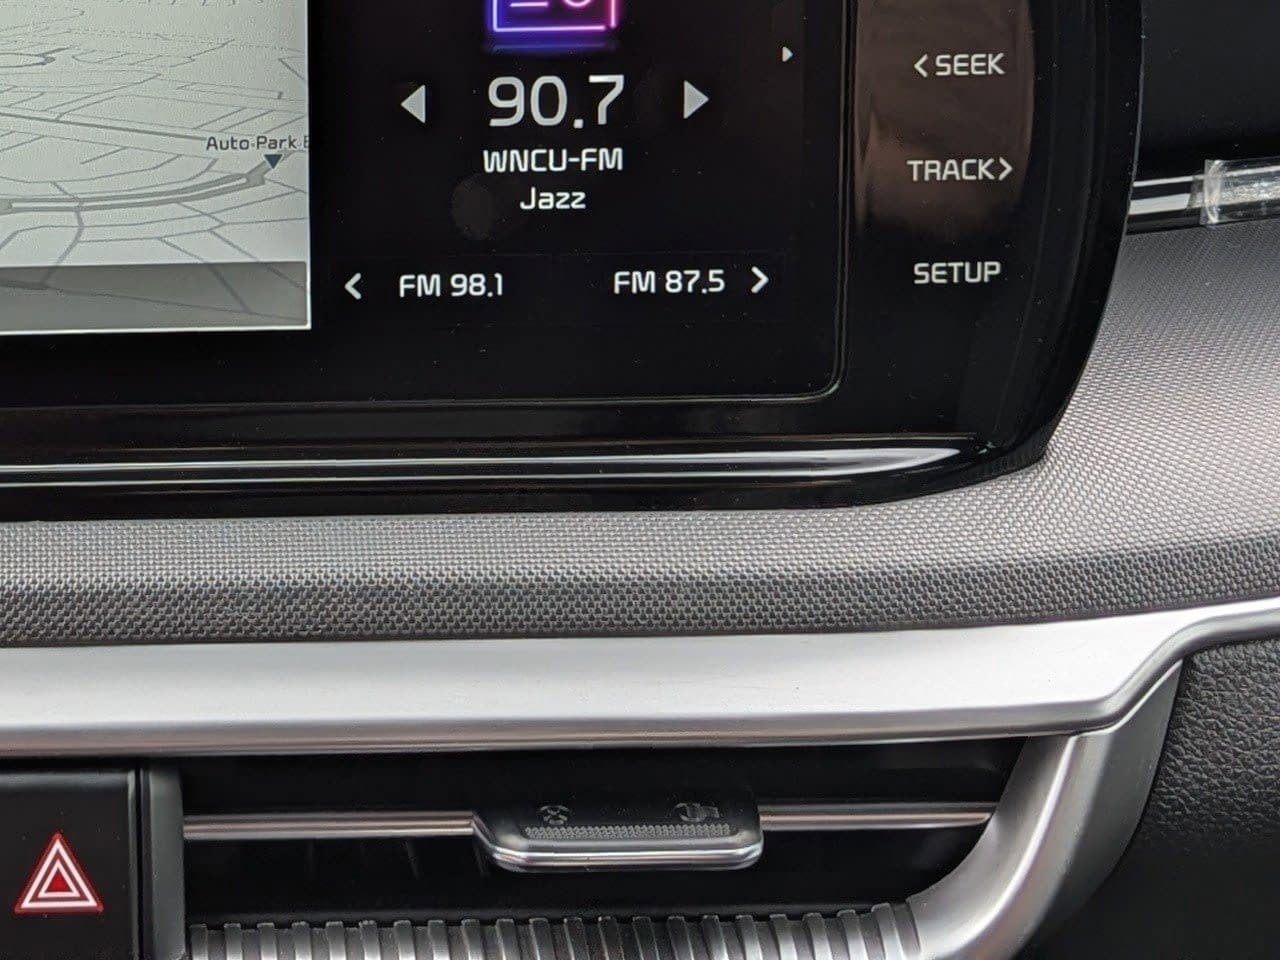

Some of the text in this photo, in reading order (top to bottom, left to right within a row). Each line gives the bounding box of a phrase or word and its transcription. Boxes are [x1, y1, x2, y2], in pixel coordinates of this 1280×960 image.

[488, 74, 625, 129] 90.7
[206, 136, 250, 151] Auto
[256, 135, 297, 150] Park
[483, 148, 624, 173] WNCU-FM
[520, 187, 587, 211] Jazz
[613, 270, 726, 294] FM 87.5
[913, 261, 1001, 285] SETUP
[399, 273, 504, 298] FM 98.1
